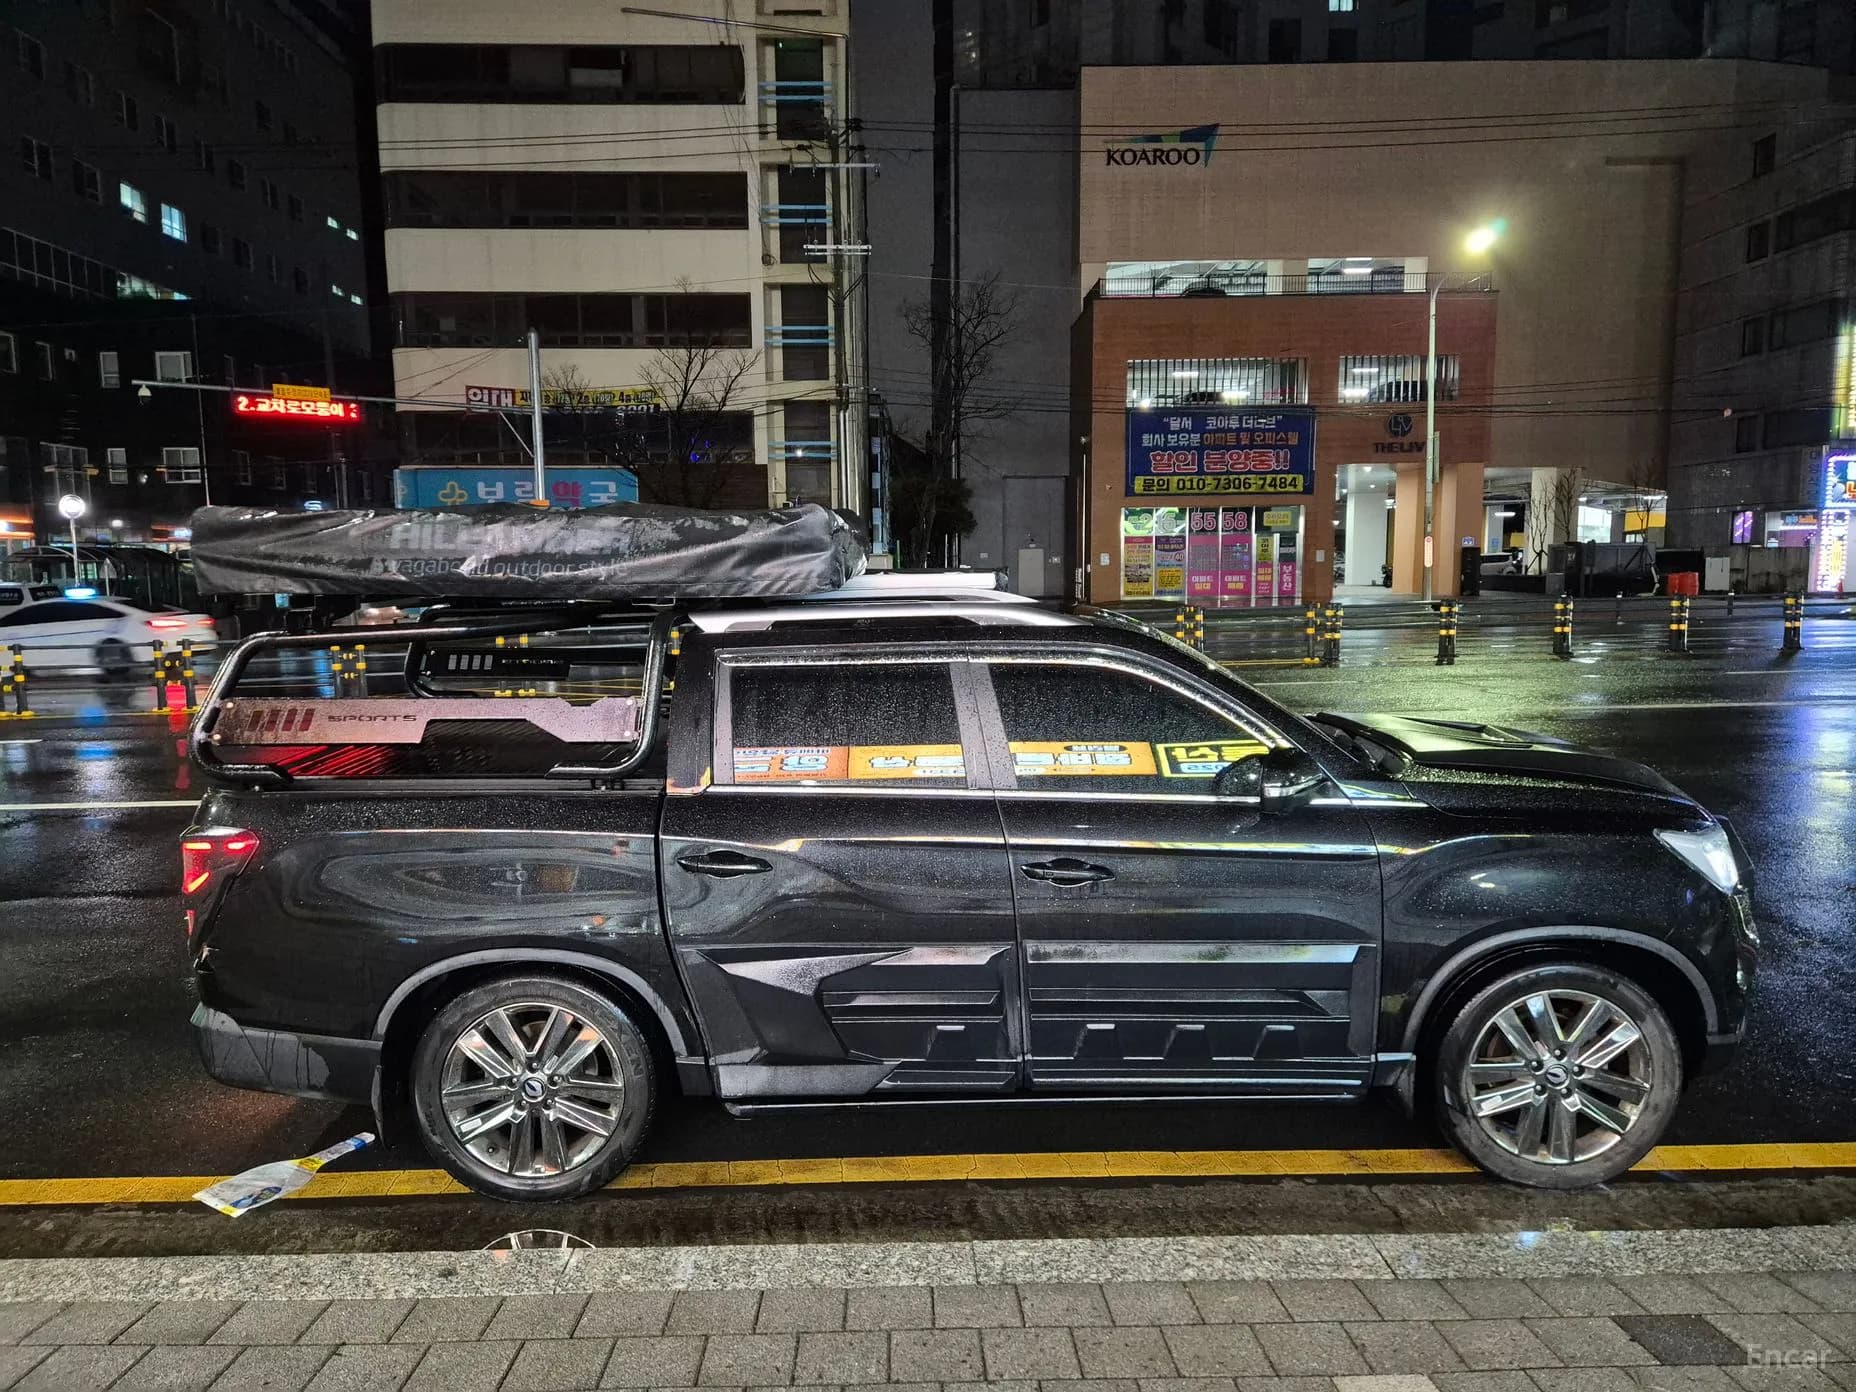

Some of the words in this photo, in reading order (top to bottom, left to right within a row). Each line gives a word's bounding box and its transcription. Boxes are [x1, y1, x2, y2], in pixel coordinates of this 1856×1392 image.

[1105, 148, 1201, 166] KOAROO
[1206, 416, 1240, 430] 코아루
[1142, 433, 1166, 448] 회사
[1167, 433, 1201, 447] 보유분
[1203, 432, 1238, 446] 아파트
[1254, 431, 1299, 446] 오피스텔
[1150, 450, 1198, 473] 할인
[1204, 449, 1290, 472] 분양중!!
[1142, 478, 1170, 493] 문의
[1176, 476, 1298, 491] 010-7306-7484
[1190, 511, 1217, 531] 55
[1222, 511, 1248, 531] 58
[327, 714, 417, 722] SPORTS
